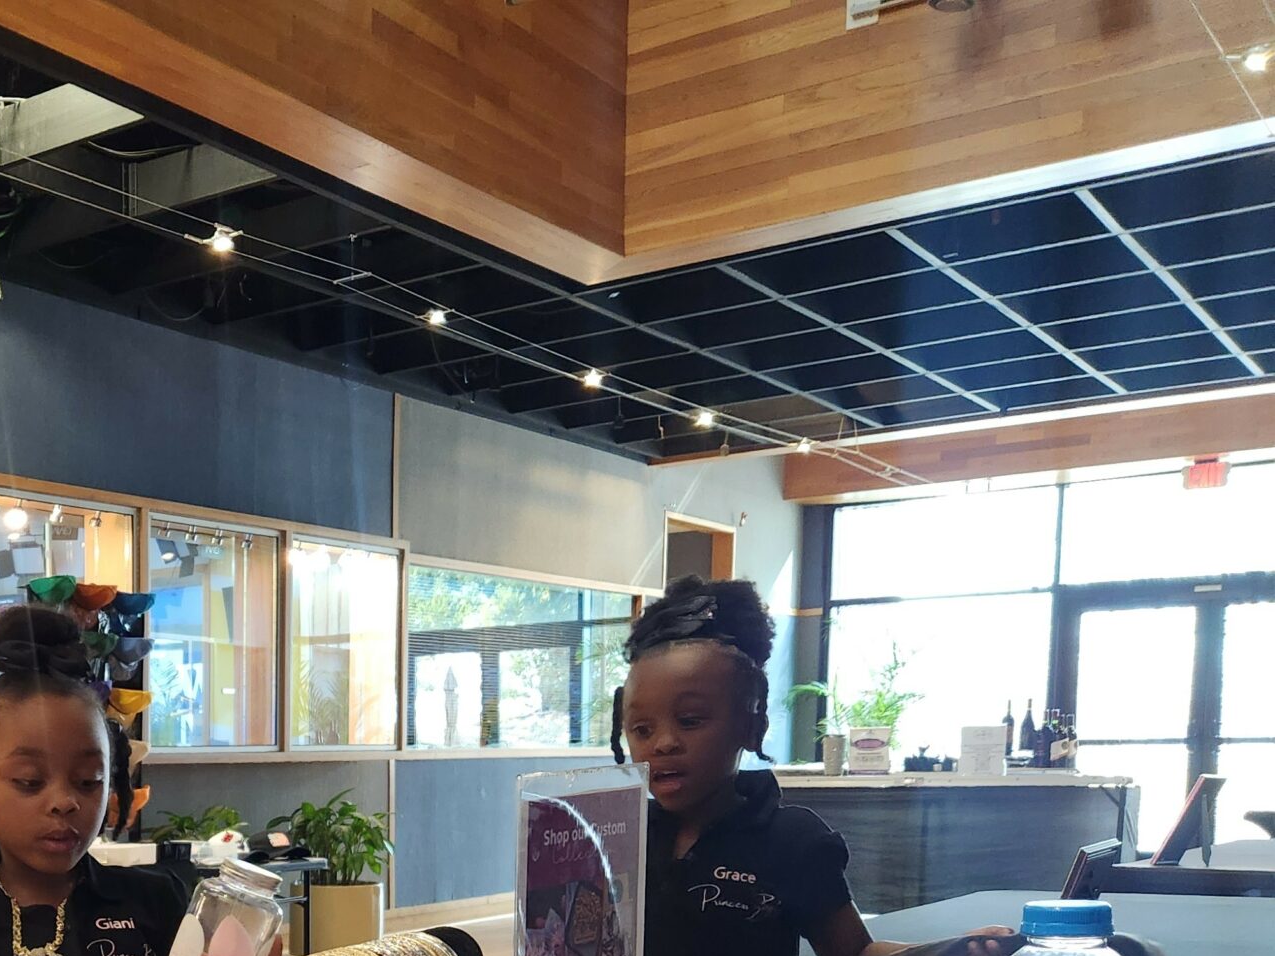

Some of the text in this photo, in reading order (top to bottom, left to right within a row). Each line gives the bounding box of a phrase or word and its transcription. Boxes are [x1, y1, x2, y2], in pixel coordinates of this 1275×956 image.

[543, 829, 570, 848] Shop
[713, 866, 757, 884] Grace
[686, 883, 749, 912] Princess
[95, 917, 135, 930] Giani
